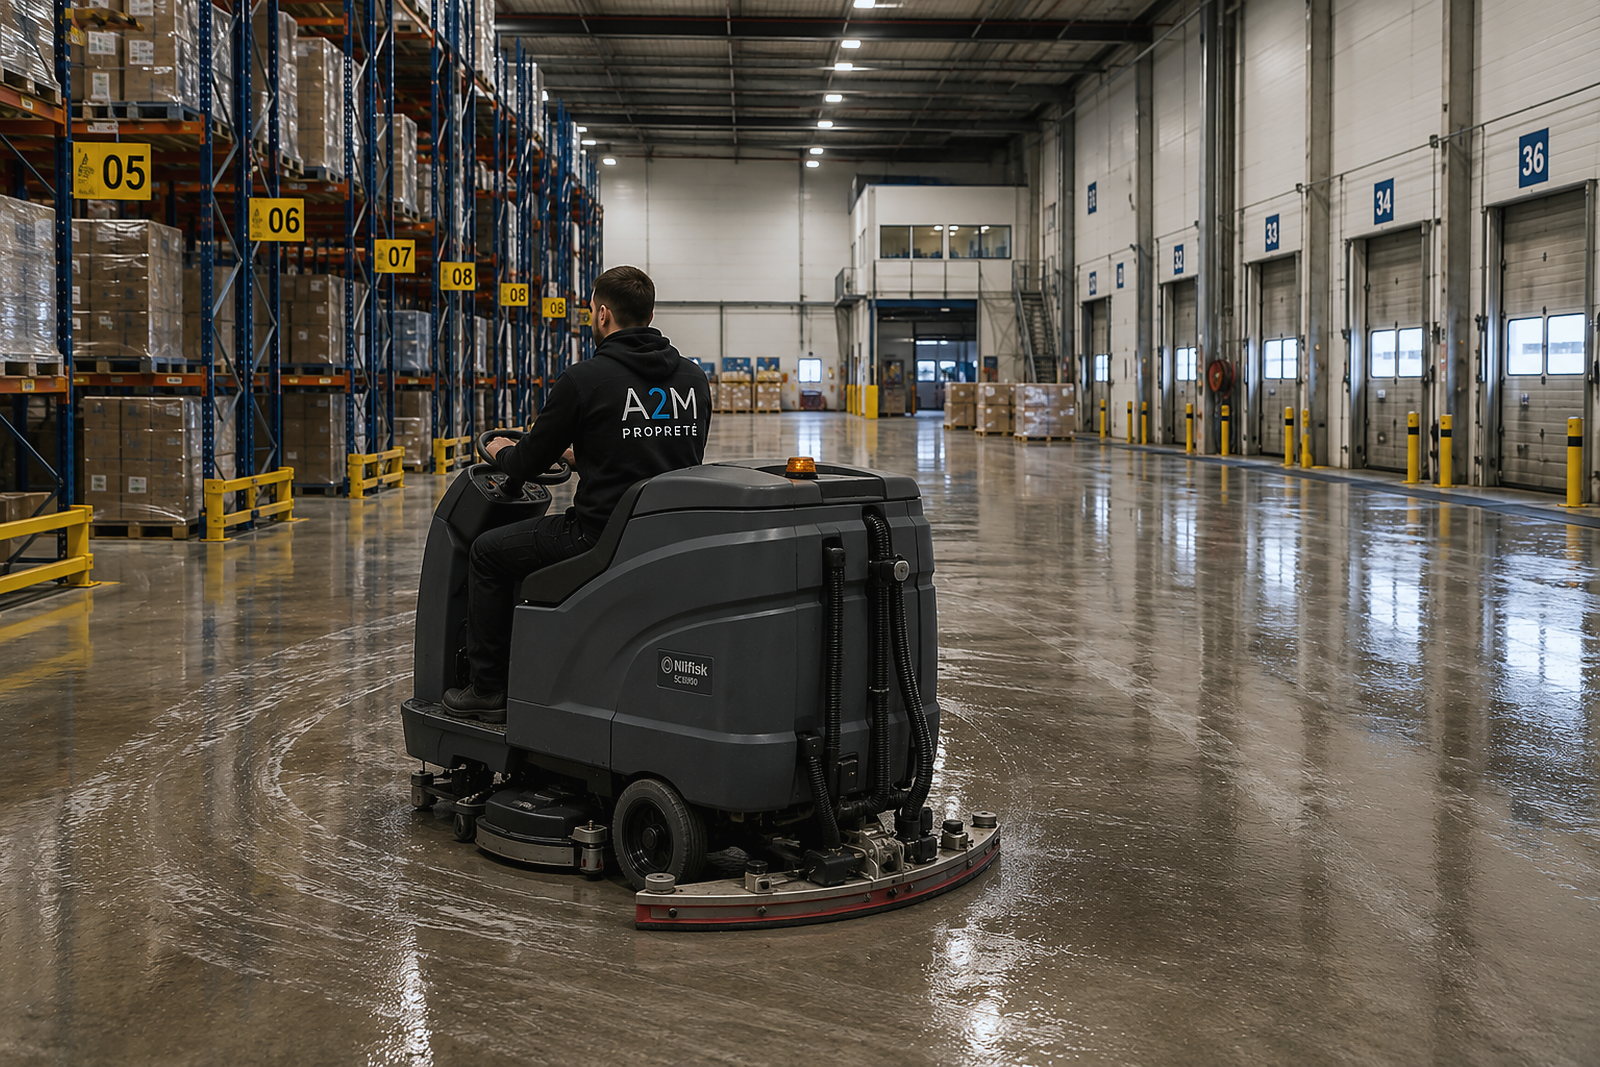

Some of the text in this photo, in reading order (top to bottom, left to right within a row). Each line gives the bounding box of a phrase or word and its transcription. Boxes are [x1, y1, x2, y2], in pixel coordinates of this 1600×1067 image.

[1522, 142, 1544, 176] 36
[103, 154, 145, 190] 05
[1376, 188, 1391, 216] 34
[269, 207, 300, 233] 06
[1266, 222, 1277, 244] 33
[388, 246, 411, 267] 07
[452, 268, 472, 286] 08
[510, 288, 526, 302] 08
[550, 302, 564, 314] 08
[621, 387, 697, 421] A2M
[622, 423, 697, 439] PROPRETÉ
